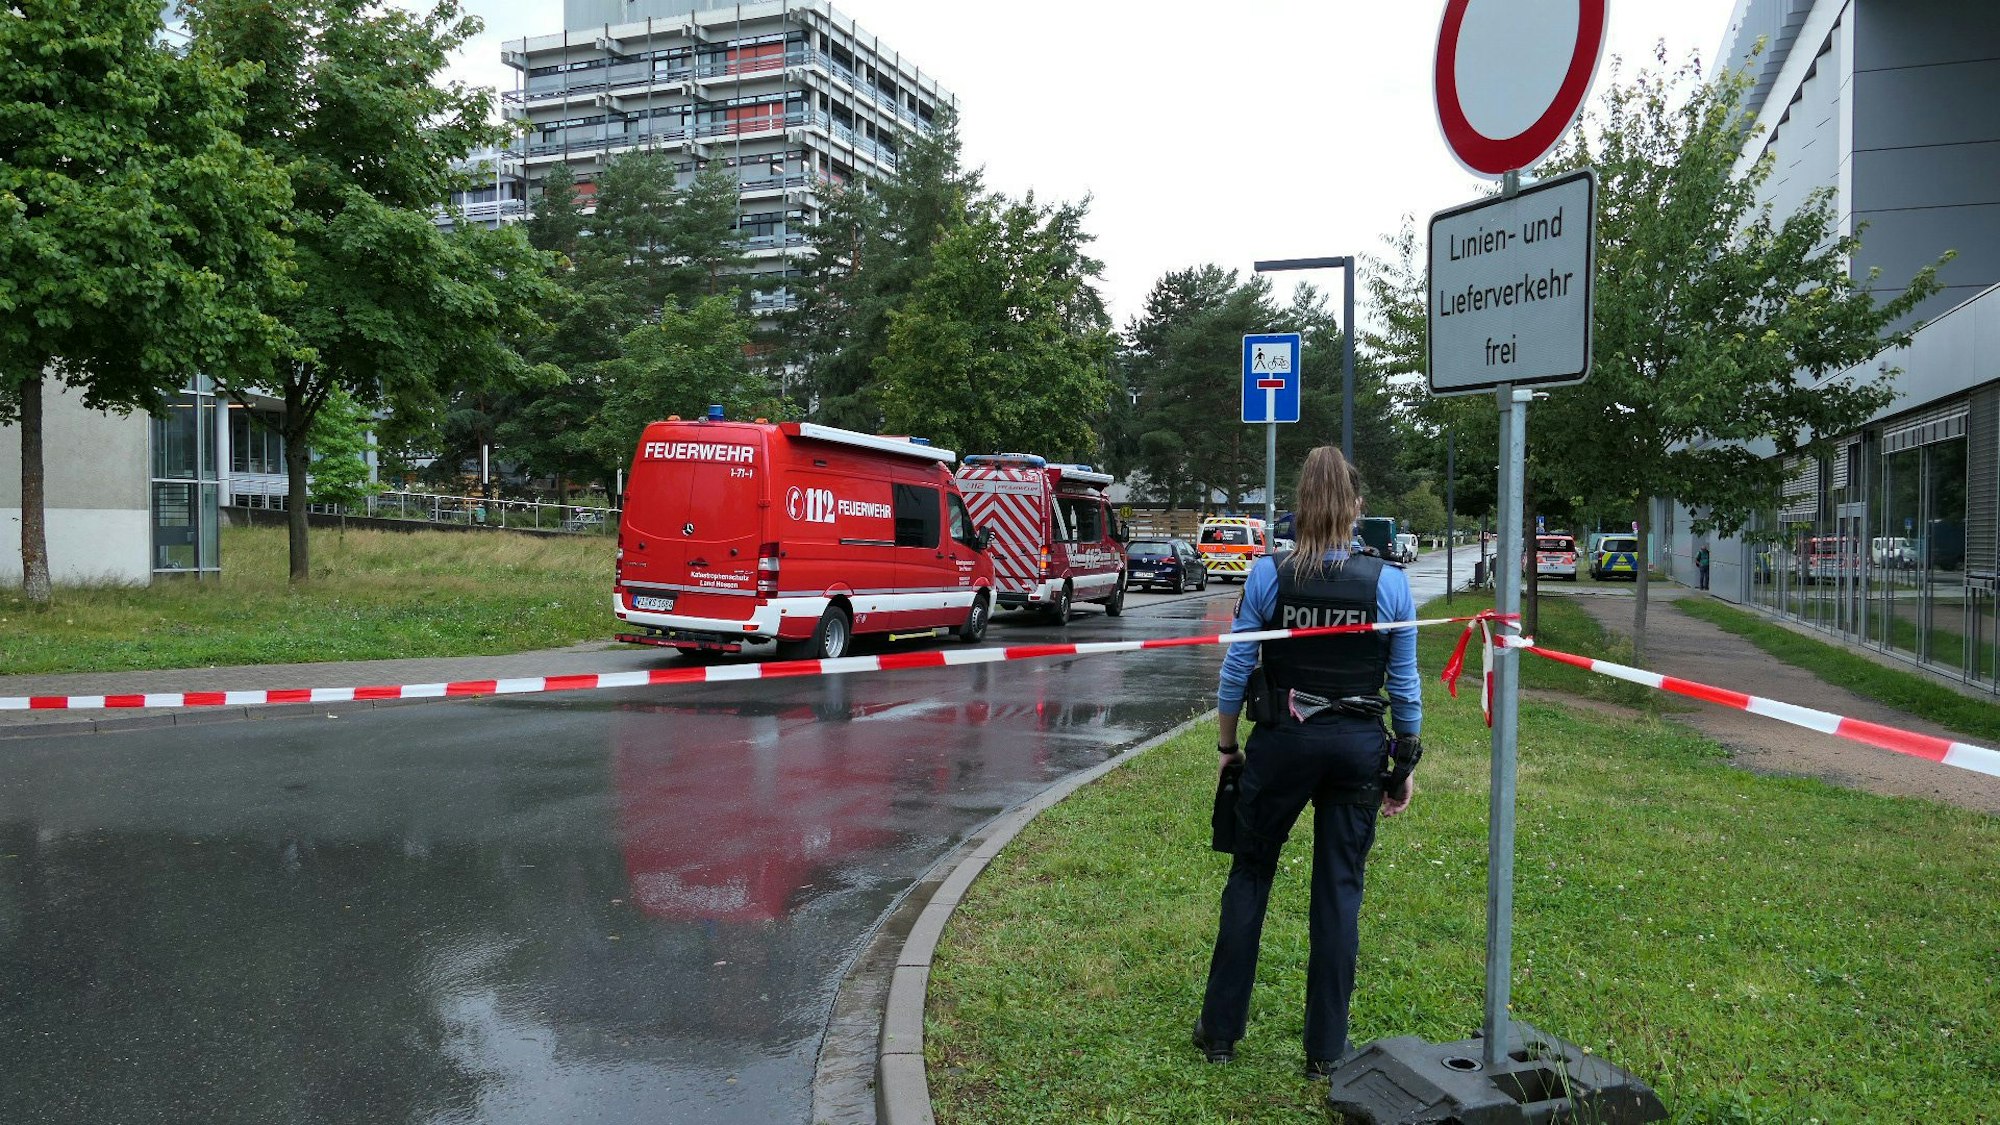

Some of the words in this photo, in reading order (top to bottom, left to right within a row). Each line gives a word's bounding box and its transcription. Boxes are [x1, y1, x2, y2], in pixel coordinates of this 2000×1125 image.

[1450, 227, 1516, 262] Linien-
[1523, 206, 1563, 245] und
[1440, 268, 1574, 317] Lieferverkehr
[1485, 334, 1516, 366] frei
[644, 442, 754, 463] FEUERWEHR
[805, 488, 835, 523] 112
[838, 500, 892, 518] FEUERWEHR
[1282, 605, 1367, 633] POLIZEI
